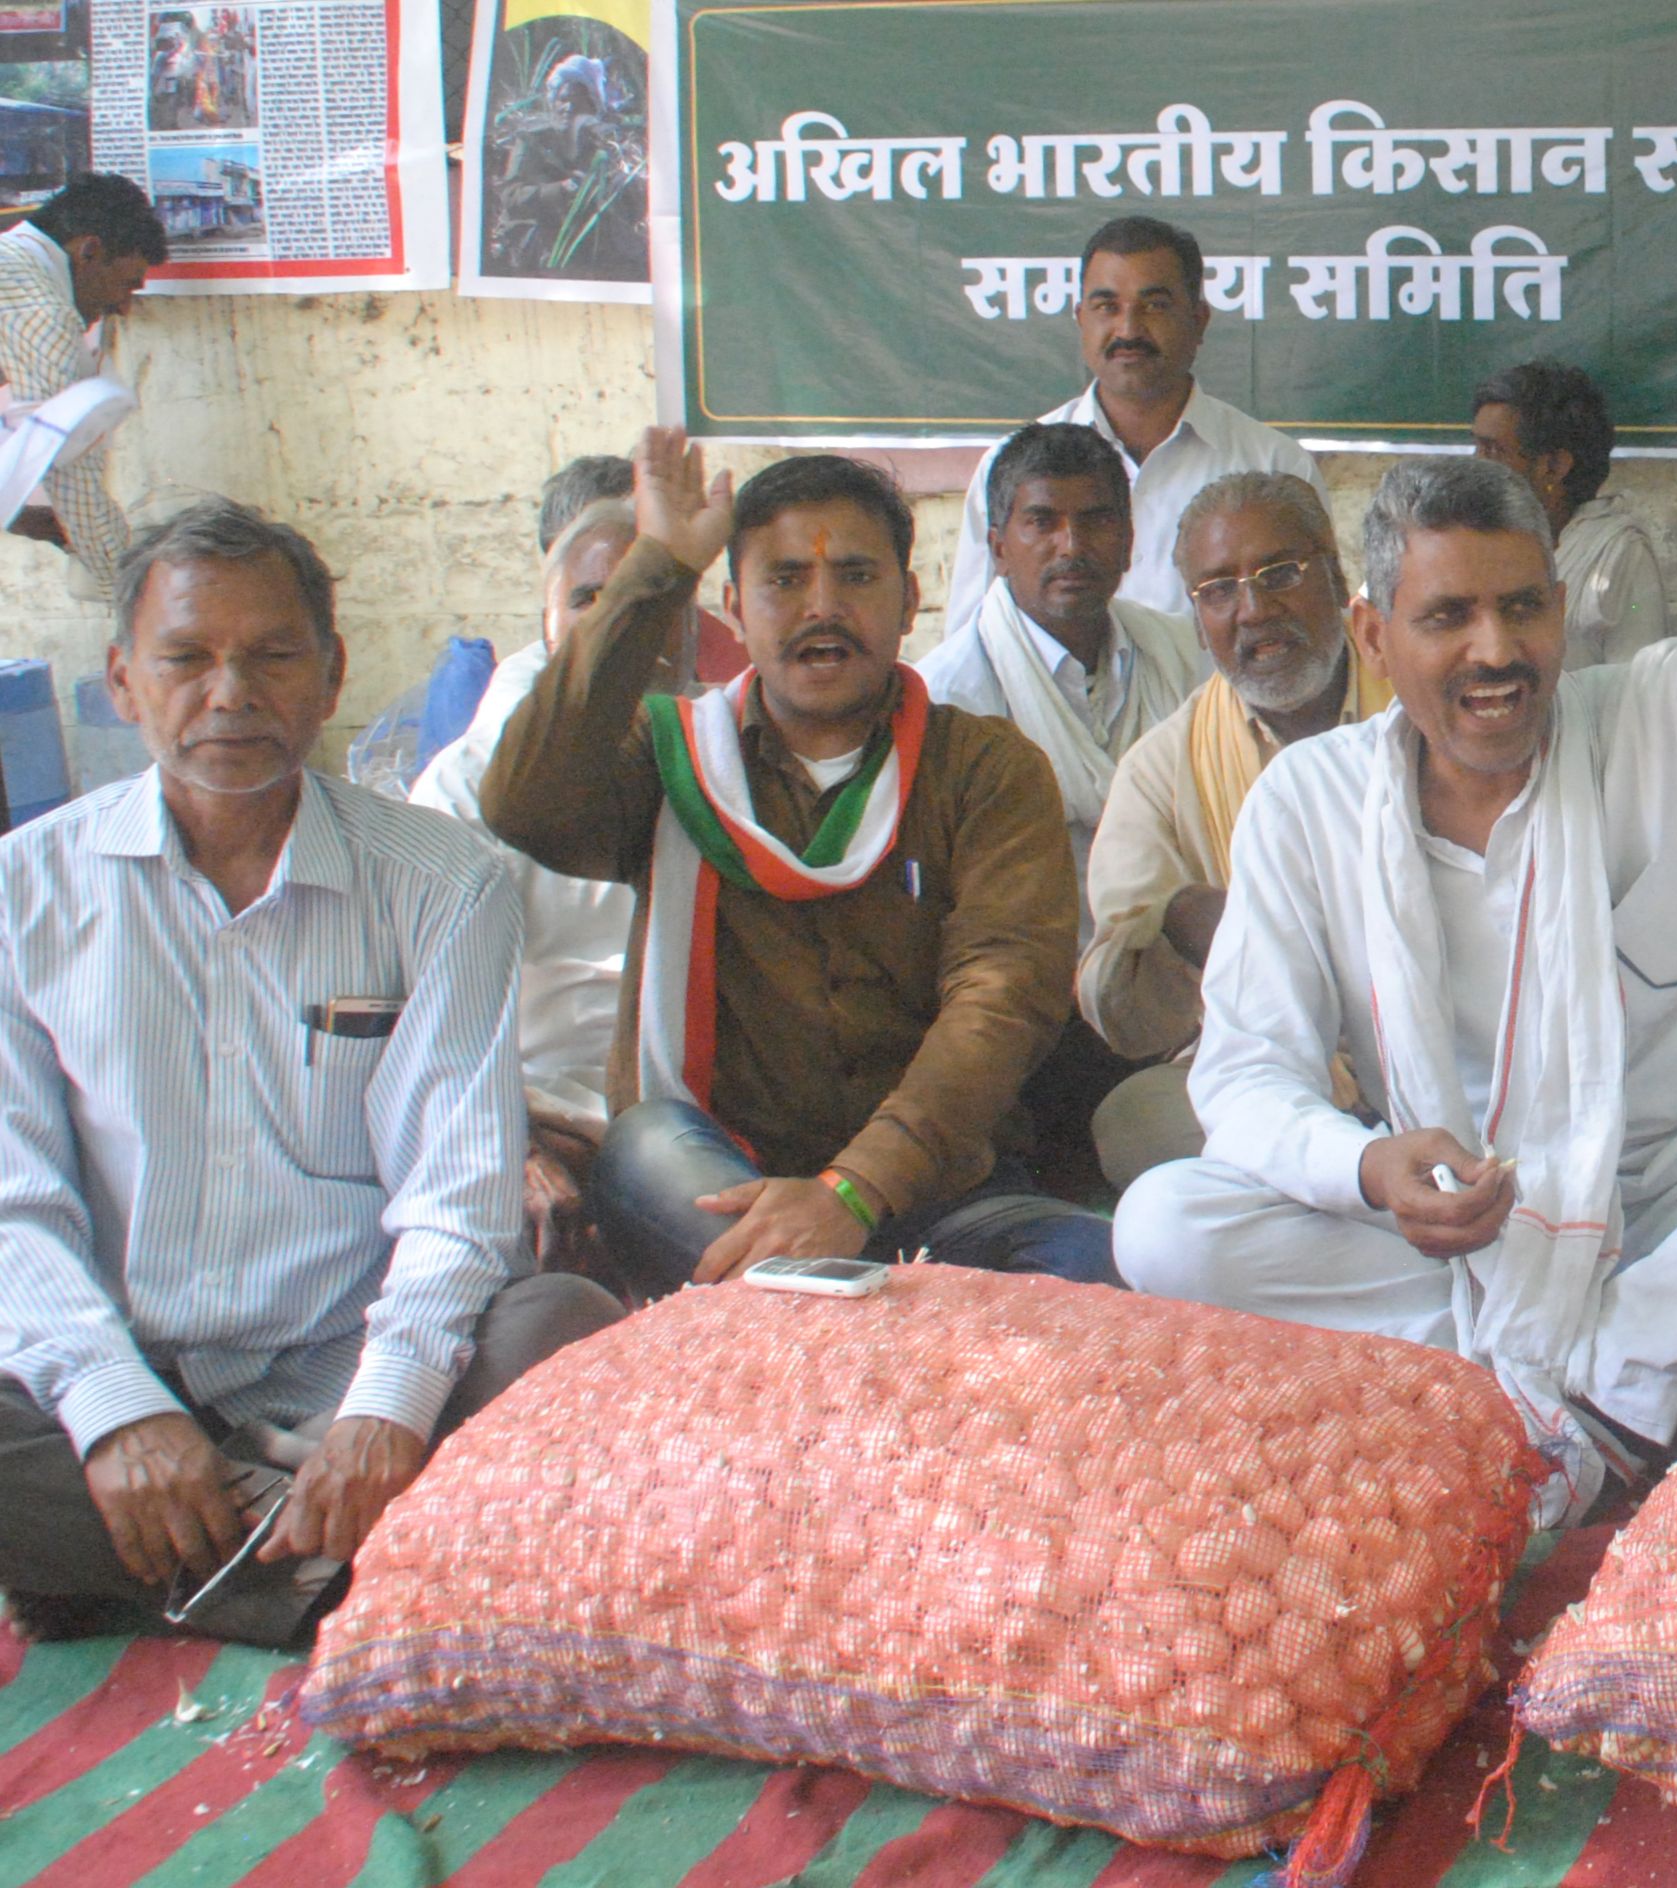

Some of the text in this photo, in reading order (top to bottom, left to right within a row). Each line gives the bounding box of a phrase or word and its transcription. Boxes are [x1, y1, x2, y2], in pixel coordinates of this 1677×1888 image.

[714, 111, 967, 201] अखिल
[986, 103, 1288, 197] भारतीय
[1305, 99, 1613, 195] किसान
[1288, 225, 1568, 320] समिति
